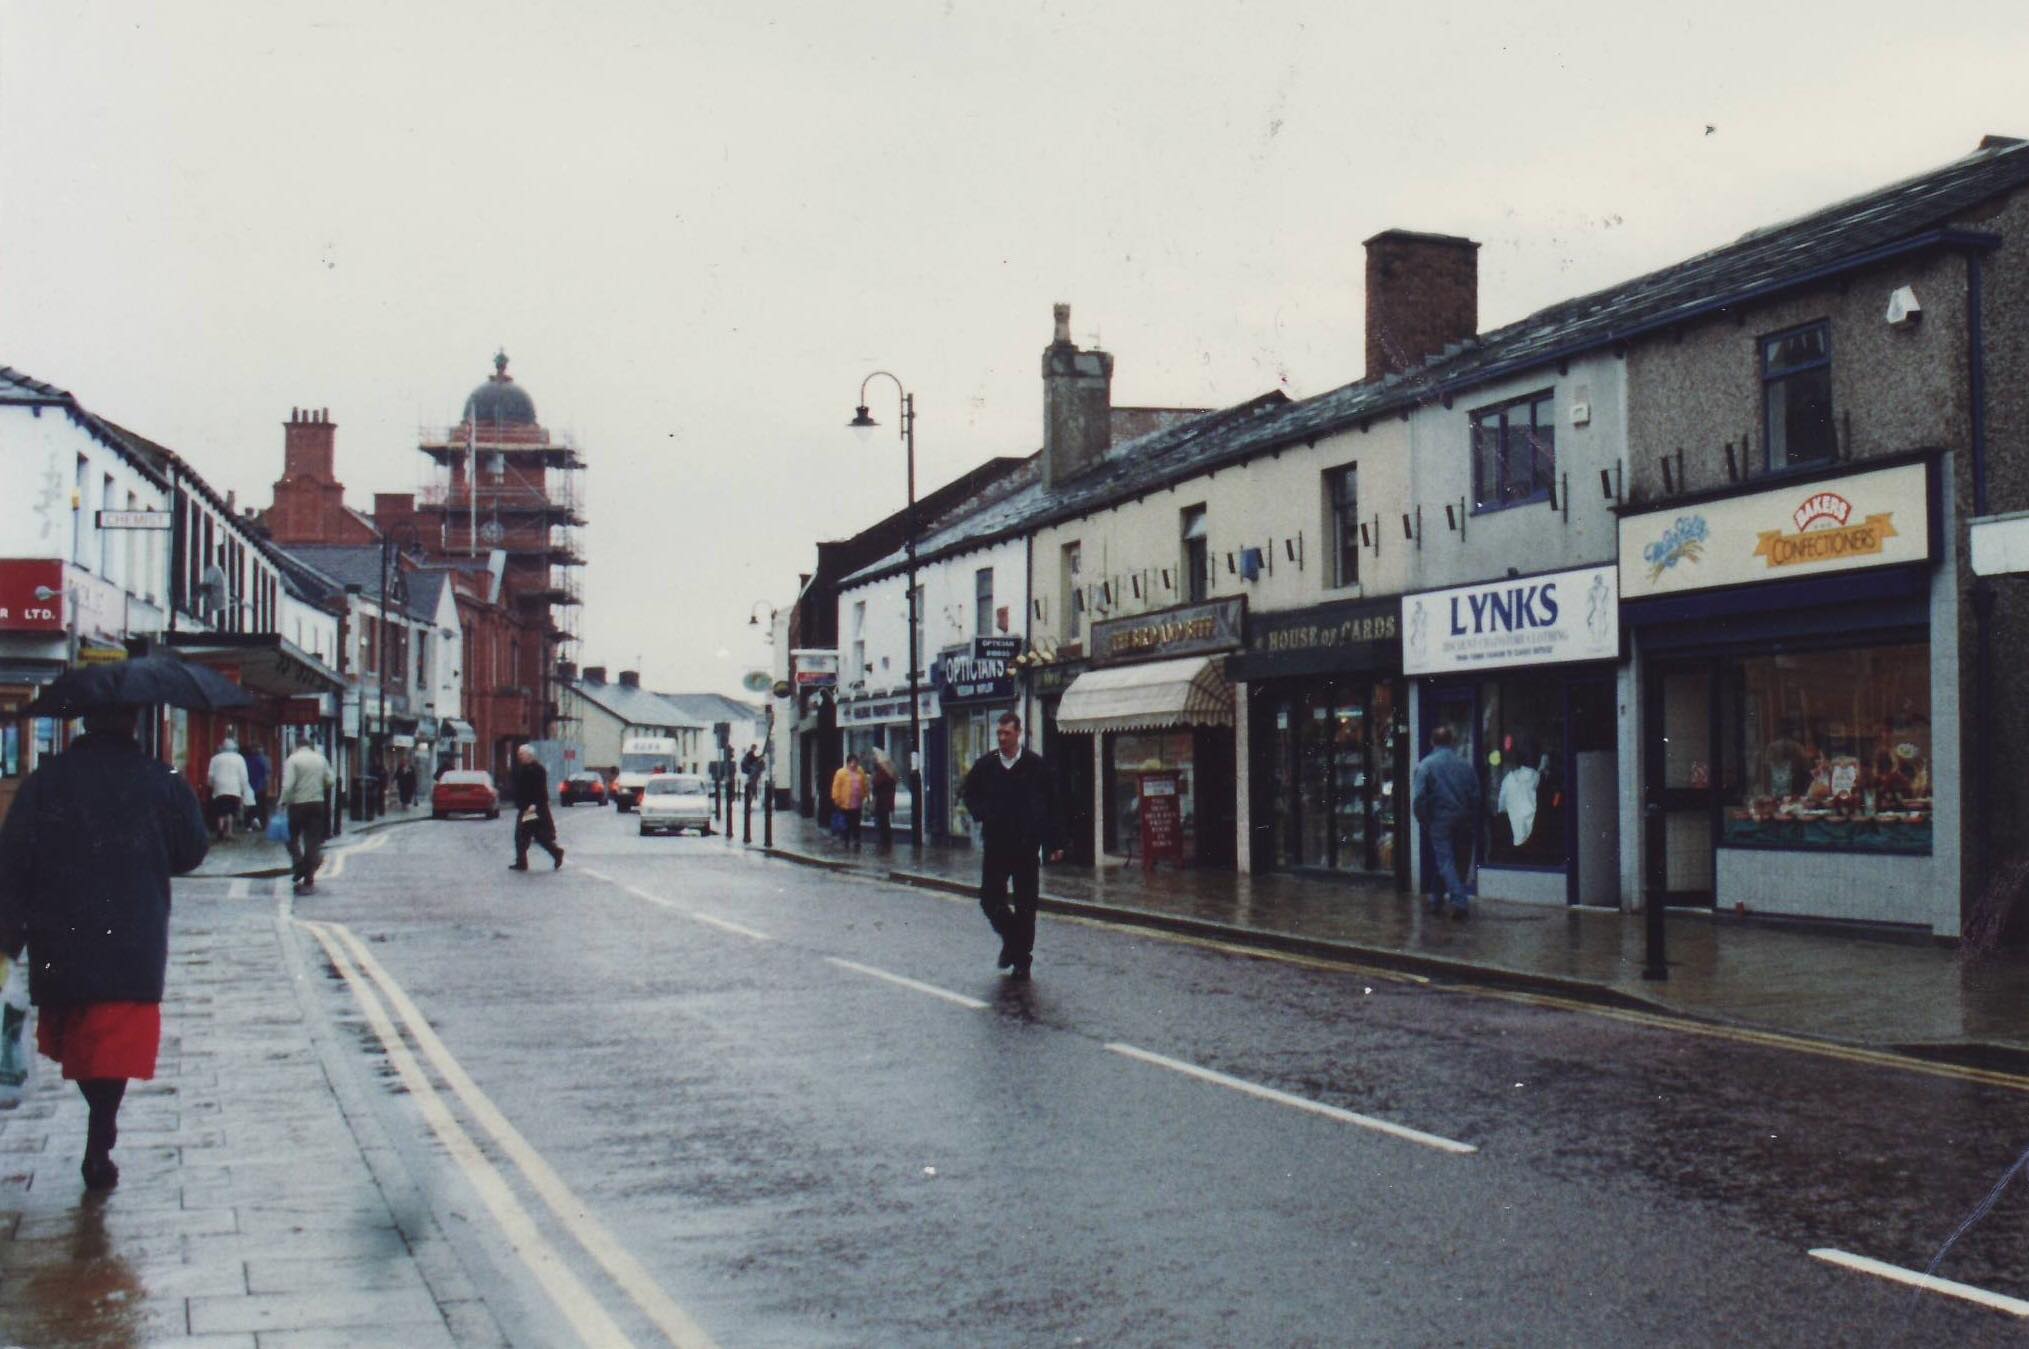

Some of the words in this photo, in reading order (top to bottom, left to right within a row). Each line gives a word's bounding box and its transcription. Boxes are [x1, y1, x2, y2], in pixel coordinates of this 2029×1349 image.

[1796, 494, 1847, 526] BAKERS
[1772, 528, 1876, 564] CONFECTIONERS
[24, 608, 56, 620] LTD.
[1450, 583, 1558, 636] LYNKS
[1269, 626, 1318, 651] HOUSE
[1338, 615, 1396, 646] CARDS
[946, 655, 1005, 684] OPTICIANS
